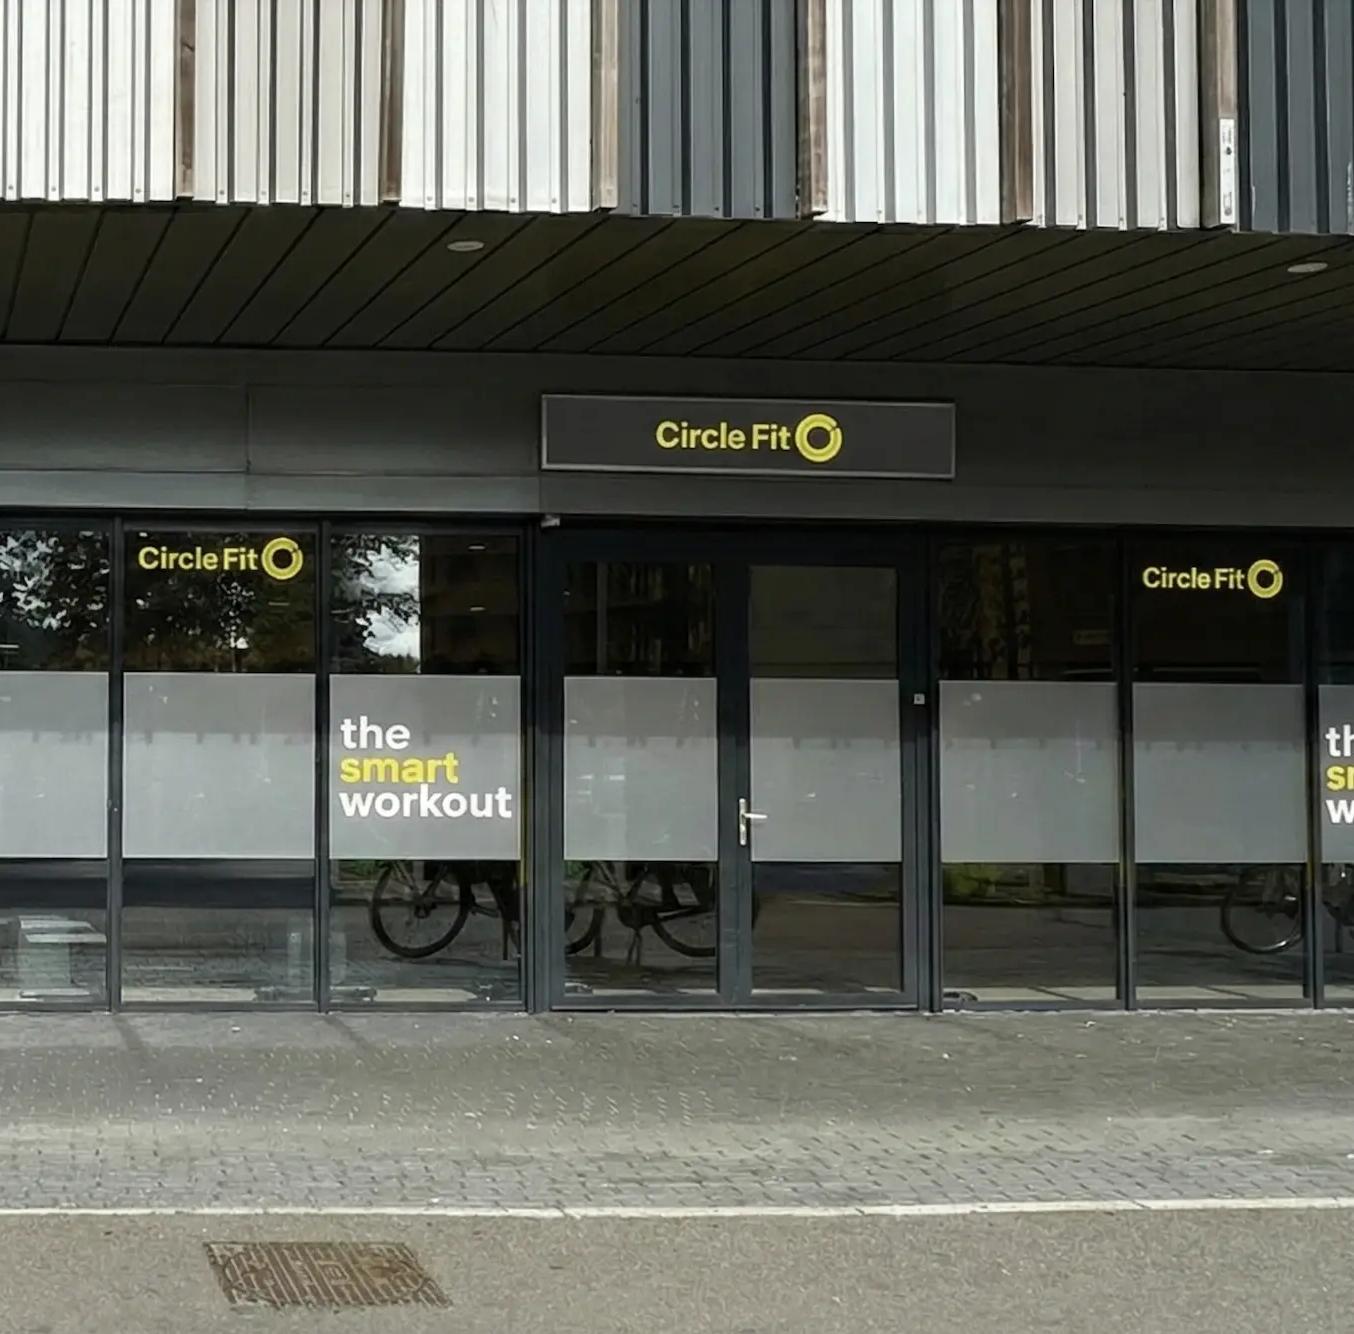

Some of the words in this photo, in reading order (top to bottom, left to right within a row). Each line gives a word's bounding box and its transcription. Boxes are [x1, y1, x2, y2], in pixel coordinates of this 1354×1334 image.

[656, 420, 746, 449] Circle
[751, 423, 791, 450] Fit
[138, 546, 218, 571] Circle
[222, 547, 258, 571] Fit
[1142, 566, 1211, 589] Circle
[1214, 567, 1245, 590] Fit
[340, 716, 411, 749] the
[340, 752, 458, 784] smart
[339, 784, 513, 818] workout
